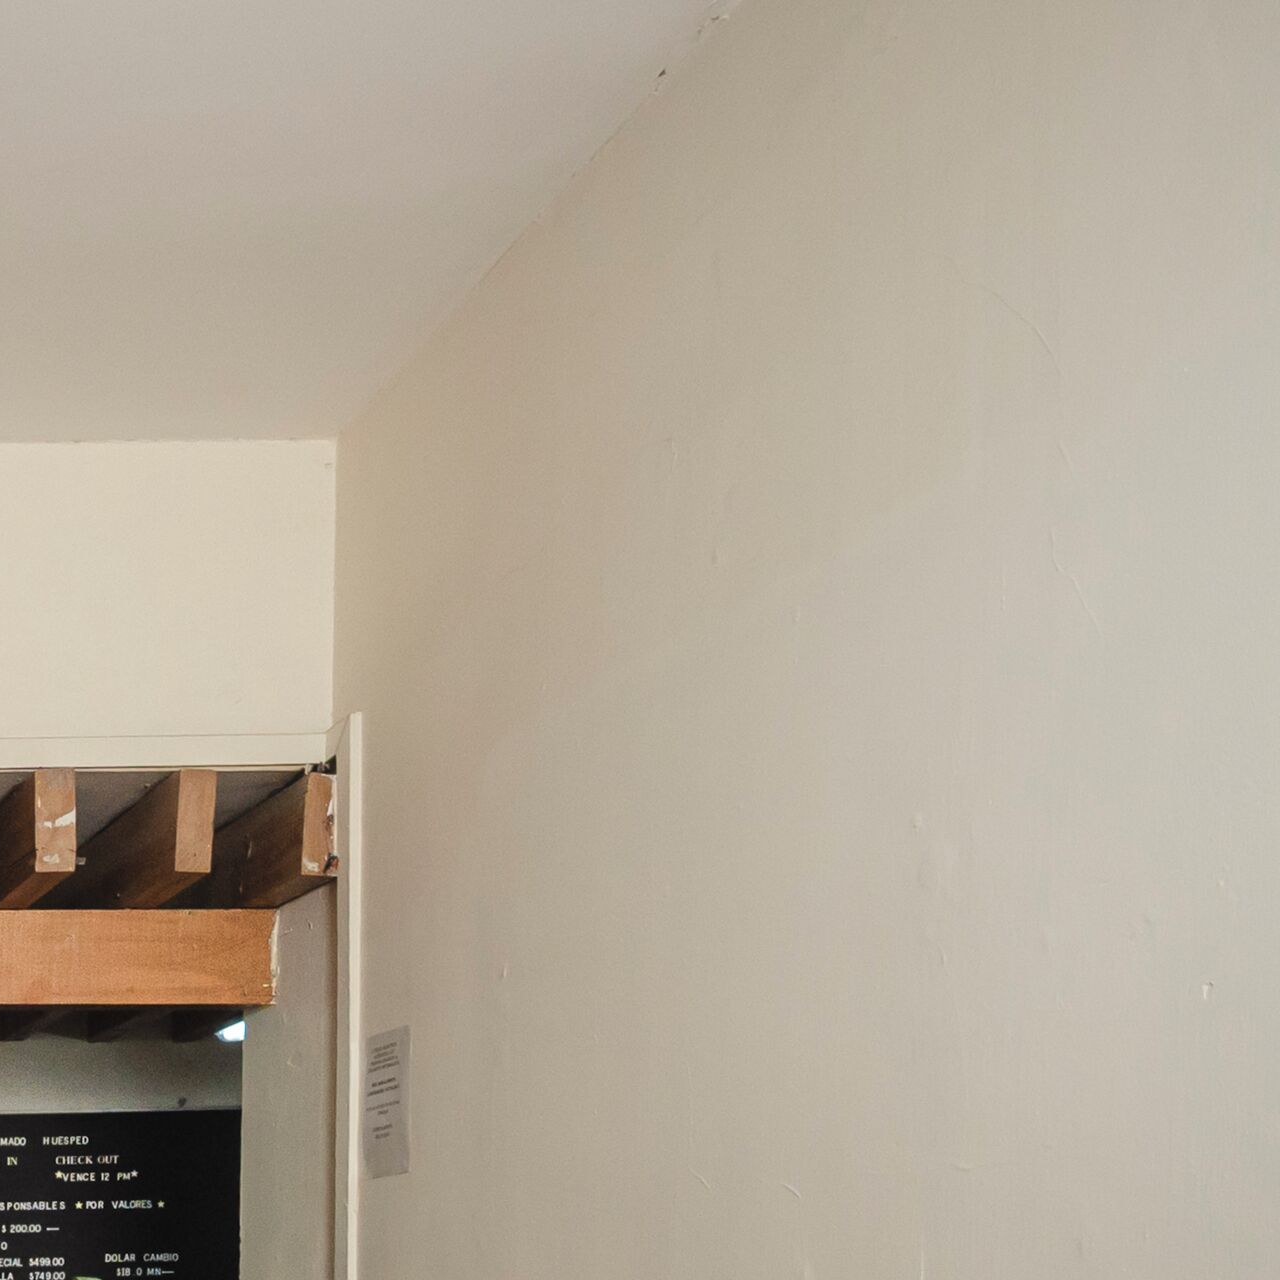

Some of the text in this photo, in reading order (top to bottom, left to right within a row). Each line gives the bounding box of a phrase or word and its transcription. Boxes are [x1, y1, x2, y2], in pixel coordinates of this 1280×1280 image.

[42, 1136, 89, 1145] HUESPED
[7, 1156, 18, 1166] IN
[56, 1156, 93, 1165] CHECK
[98, 1155, 119, 1164] OUT
[101, 1172, 110, 1181] 12
[86, 1201, 104, 1210] POR
[111, 1200, 152, 1209] VALORES
[105, 1253, 179, 1262] DOLAR CAMBIO
[29, 1272, 65, 1280] $749.00
